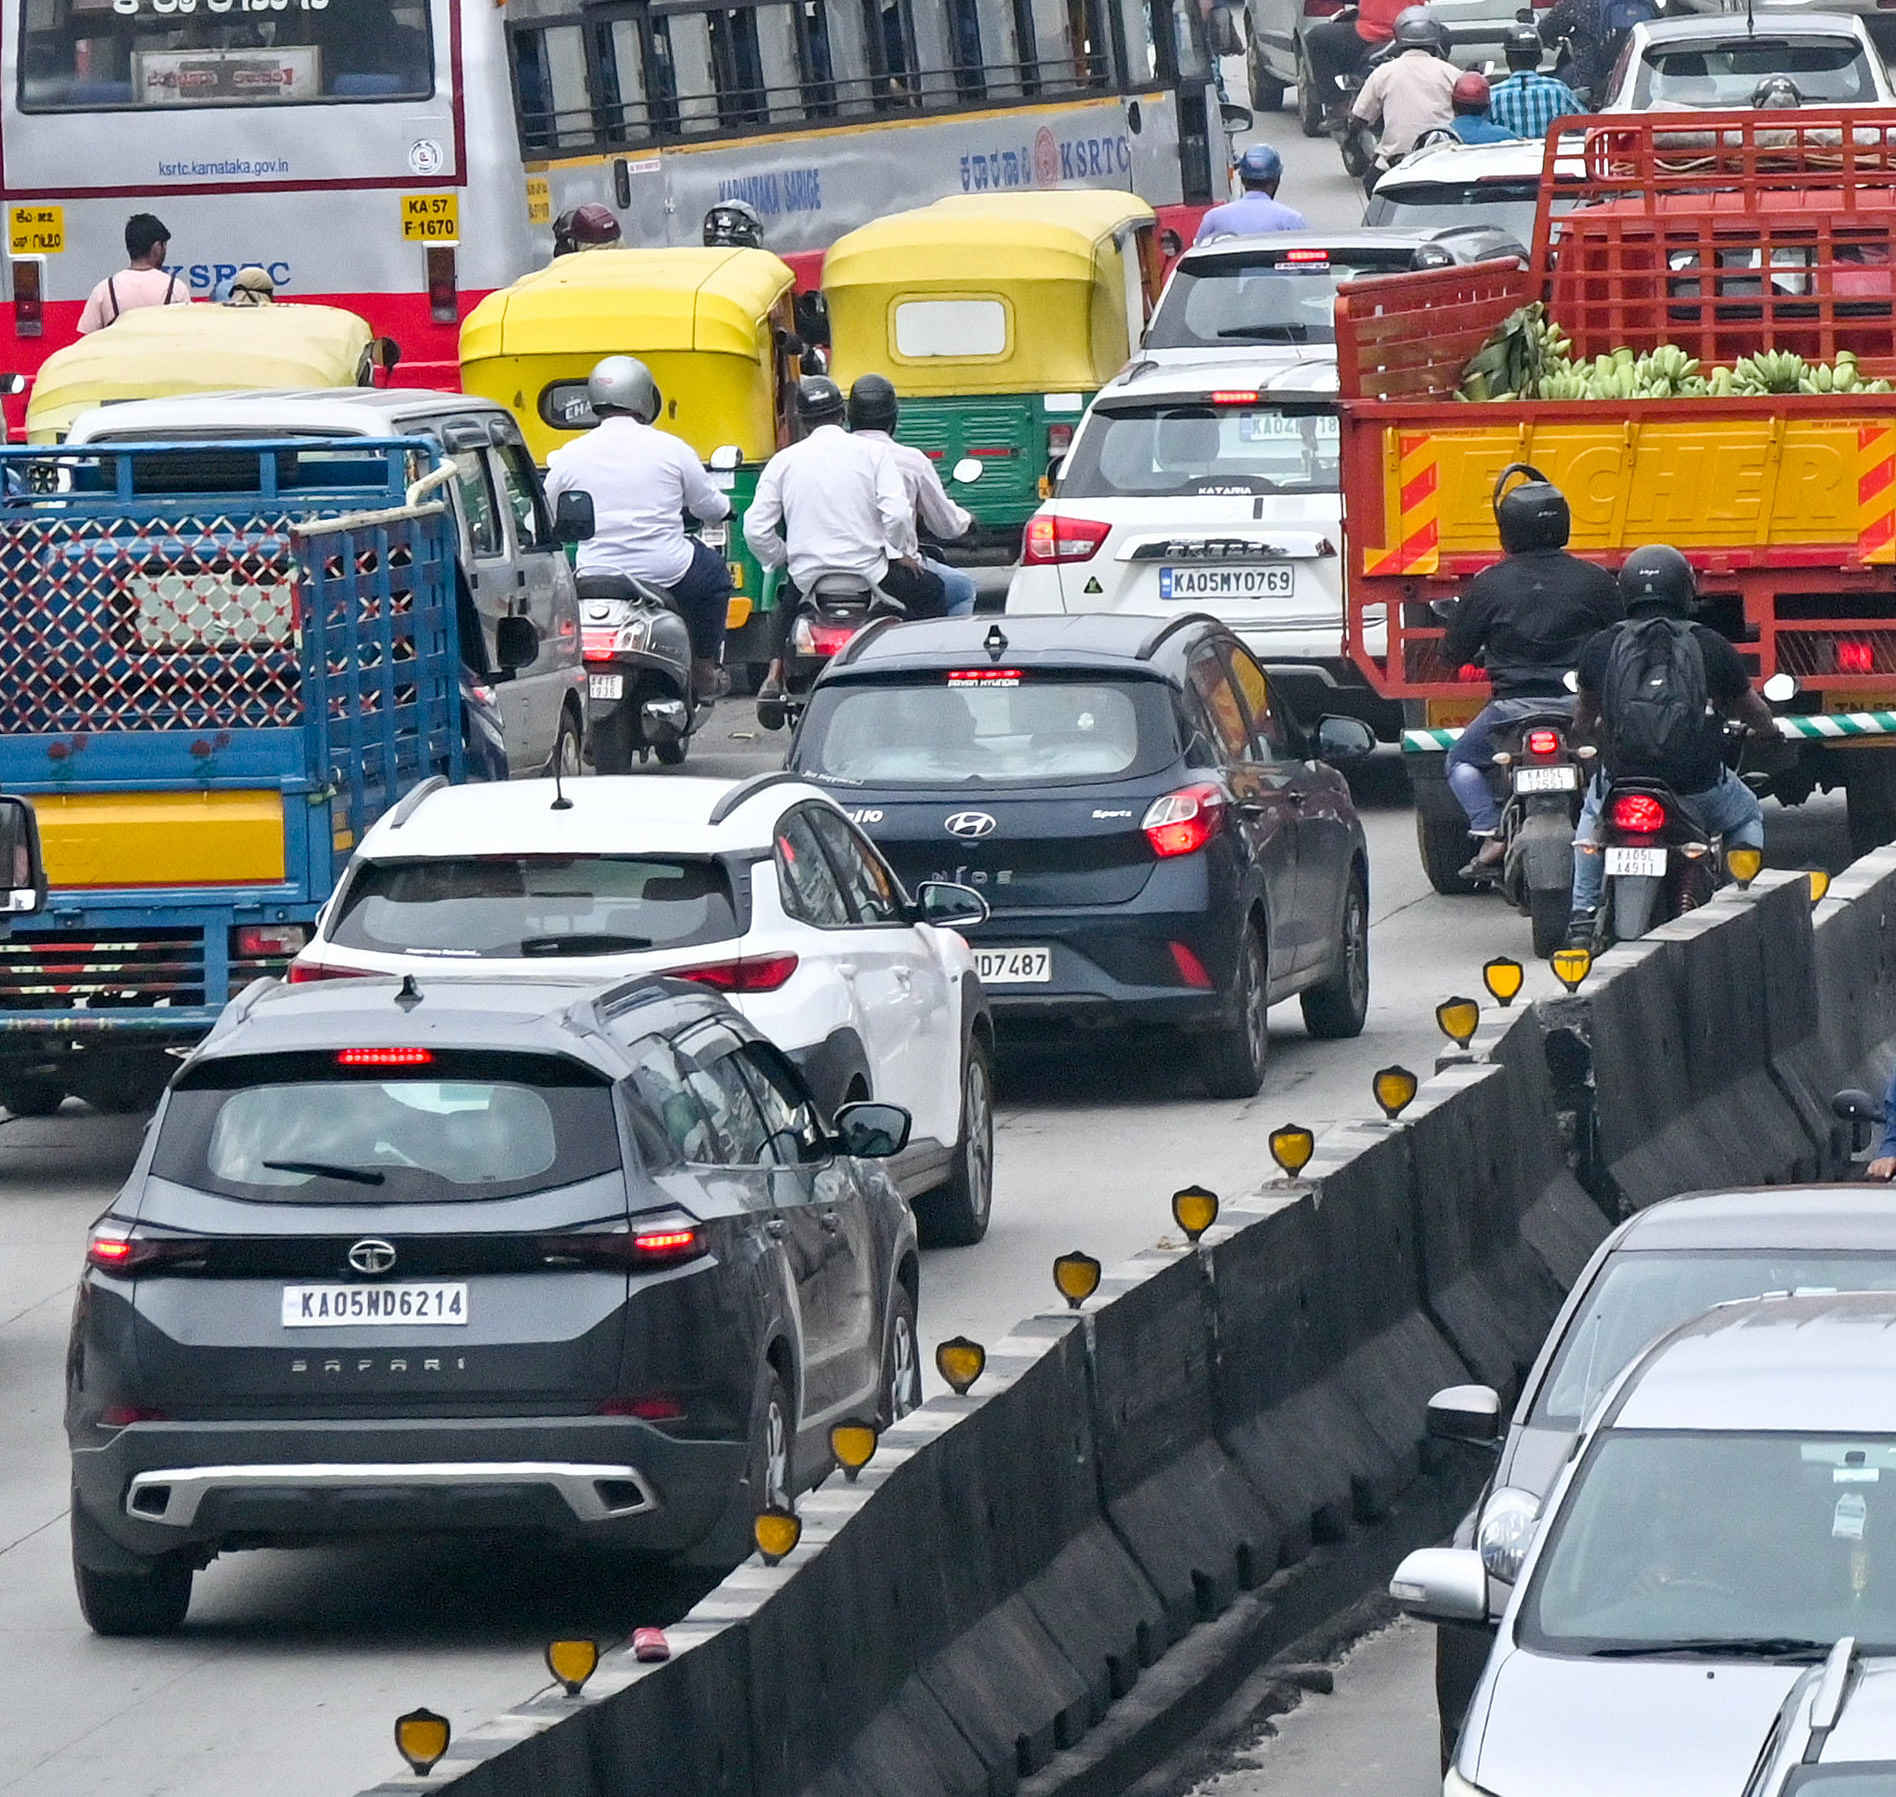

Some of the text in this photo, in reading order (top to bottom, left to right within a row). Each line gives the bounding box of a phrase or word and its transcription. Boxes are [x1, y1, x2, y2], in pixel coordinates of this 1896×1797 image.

[159, 158, 290, 176] ksrtc.karnataka.gov.in
[1060, 136, 1130, 180] KSRTC
[784, 168, 822, 212] SARIGE
[409, 199, 449, 214] KA 57
[1198, 486, 1253, 495] KATARIA
[1173, 571, 1290, 594] KA05MY0769
[1092, 809, 1132, 818] Sports
[976, 954, 1047, 977] D7487
[302, 1290, 461, 1317] KA05ND6214
[292, 1356, 467, 1373] SAFARI
